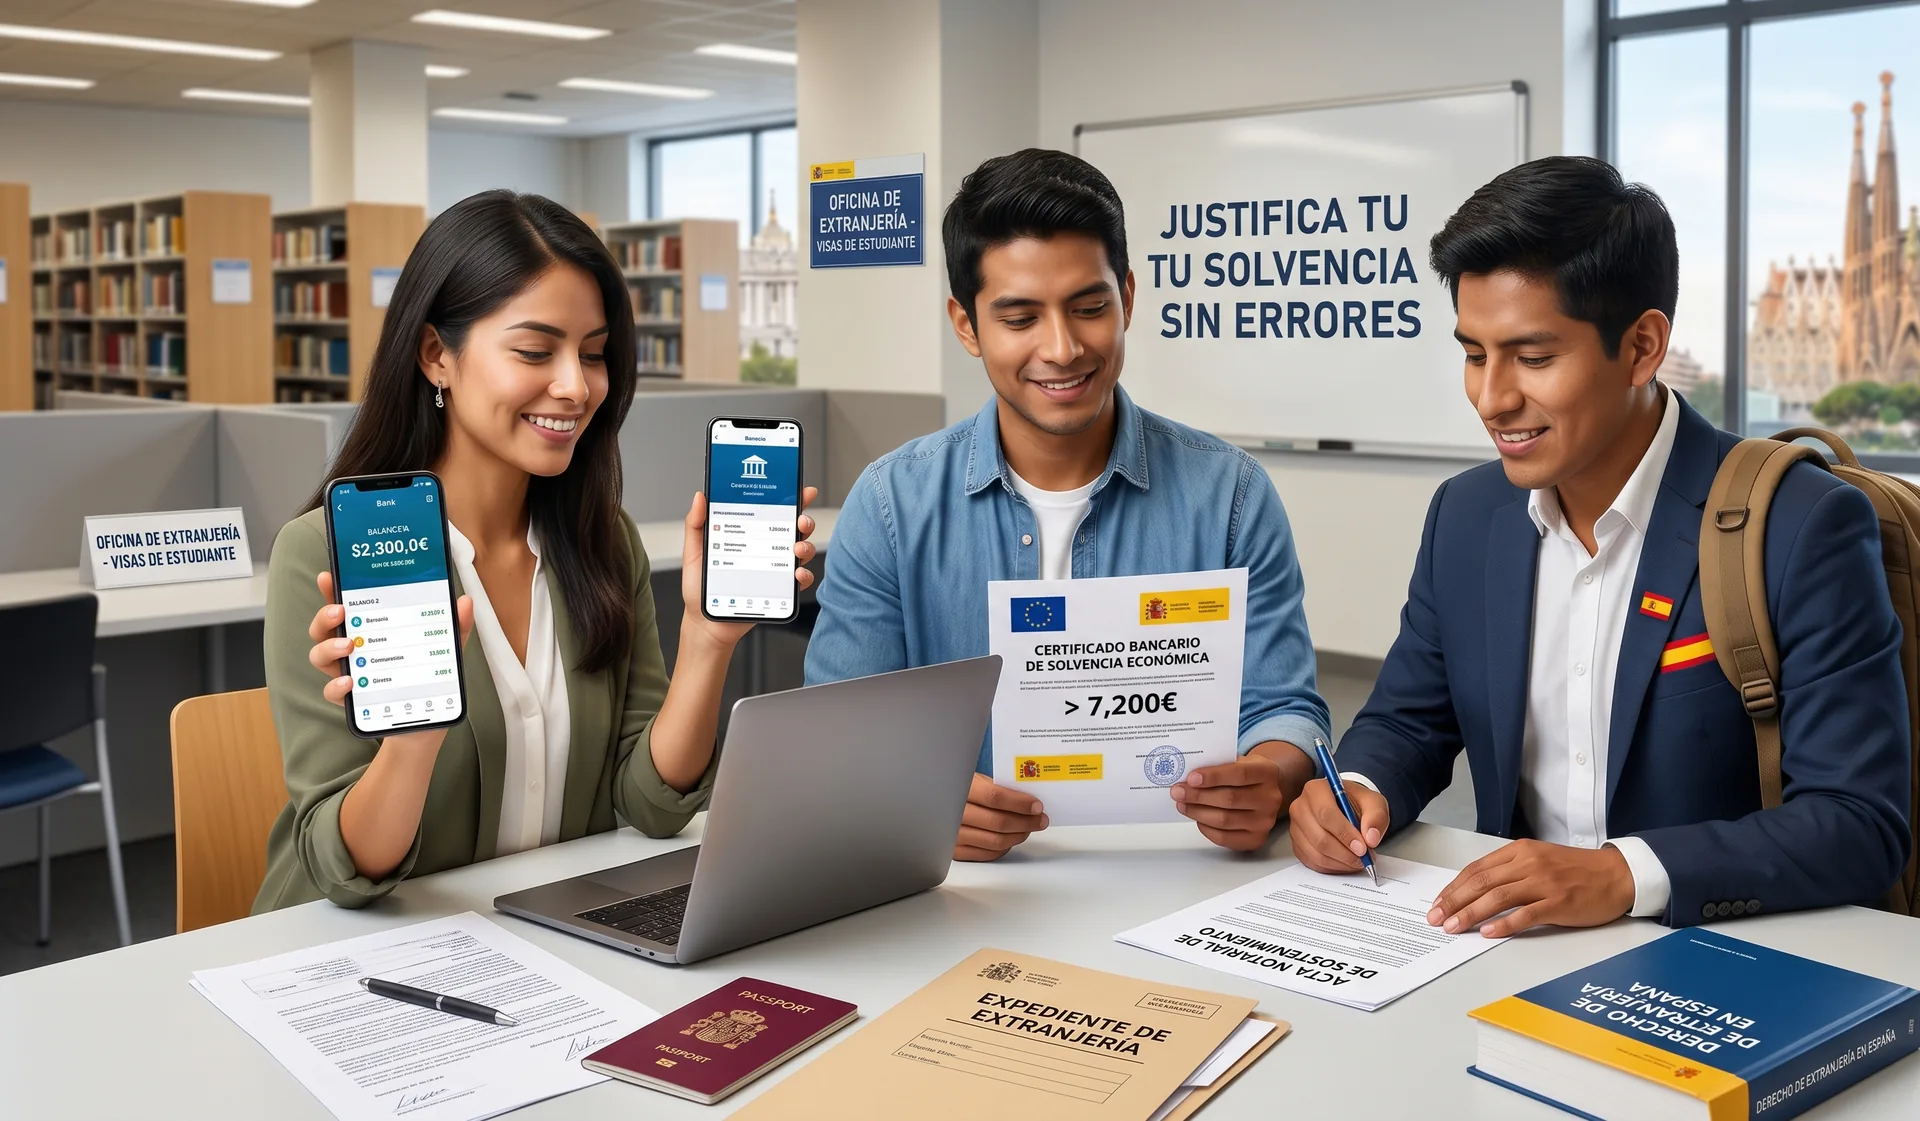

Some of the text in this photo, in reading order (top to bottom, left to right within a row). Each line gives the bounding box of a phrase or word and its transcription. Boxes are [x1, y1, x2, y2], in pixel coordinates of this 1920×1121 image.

[829, 189, 901, 211] OFICINA DE
[820, 208, 908, 233] EXTRANJERÍA
[1160, 194, 1408, 239] JUSTIFICA TU
[816, 235, 916, 252] VISAS DE ESTUDIANTE
[1148, 247, 1418, 288] TU SOLVENCIA
[1160, 300, 1422, 339] SIN ERRORES
[376, 498, 396, 507] Bank
[96, 523, 241, 550] OFICINA DE EXTRANJERÍA
[351, 537, 429, 558] $2,300,0€
[111, 553, 146, 569] VISAS
[148, 551, 164, 566] DE
[166, 546, 236, 565] ESTUDIANTE
[1034, 637, 1201, 656] CERTIFICADO BANCARIO
[1025, 652, 1210, 672] DE SOLVENCIA ECONÓMICA
[1064, 692, 1178, 719] > 7,200€
[1174, 933, 1351, 986] ACTA NOTARIAL DE
[1199, 926, 1349, 968] SOSTENIMIENTO
[1344, 965, 1379, 980] DE
[738, 990, 815, 1015] PASSPORT
[976, 992, 1132, 1034] EXPEDIENTE
[1133, 1025, 1173, 1043] DE
[1570, 997, 1722, 1054] DERECHO DE
[1716, 1012, 1756, 1030] EN
[970, 1008, 1141, 1056] EXTRANJERÍA
[1720, 1031, 1761, 1049] DE
[1756, 1029, 1896, 1114] DERECHO DE EXTRANJERÍA EN ESPAÑA
